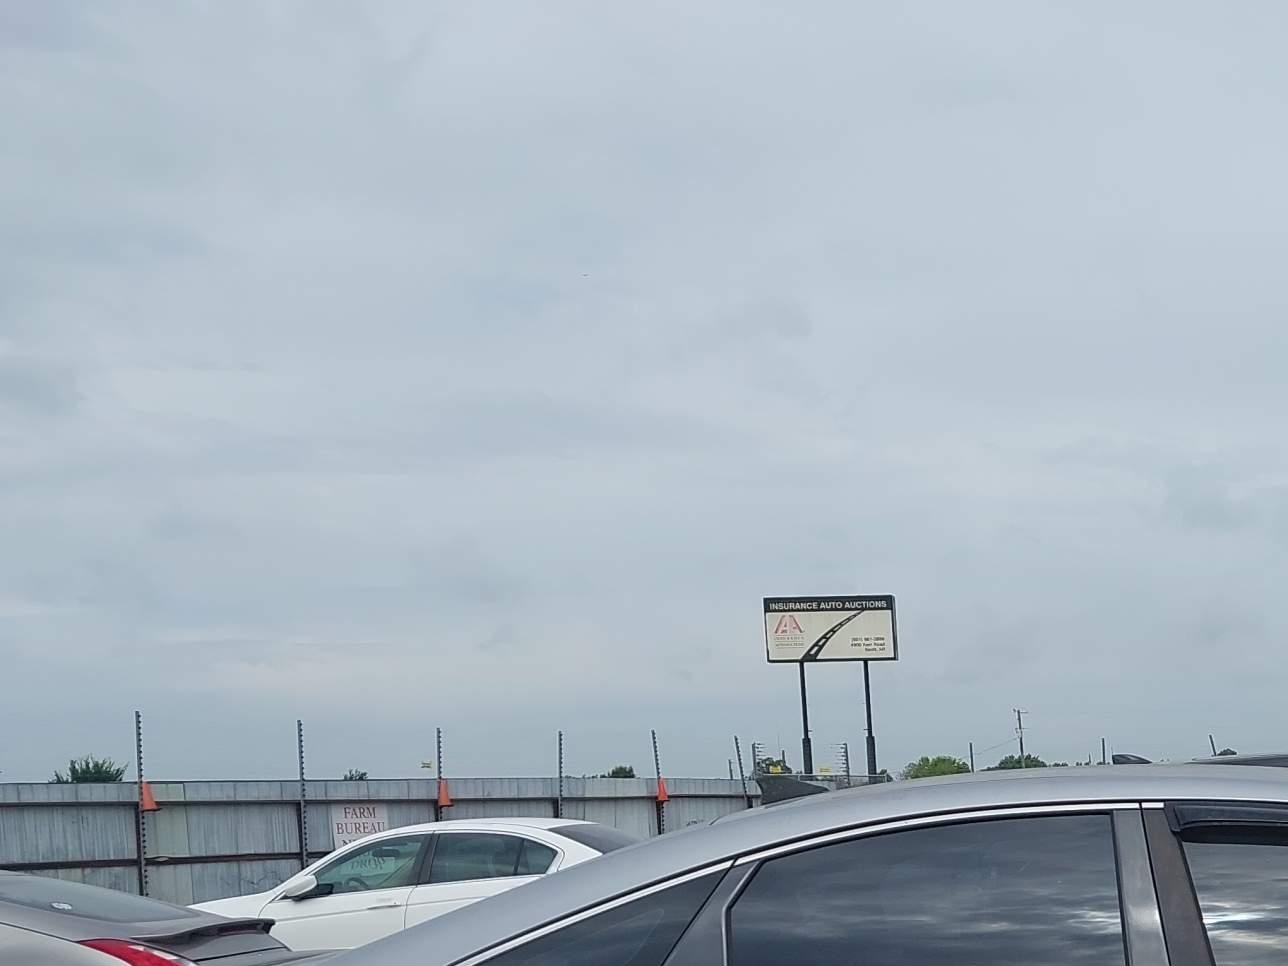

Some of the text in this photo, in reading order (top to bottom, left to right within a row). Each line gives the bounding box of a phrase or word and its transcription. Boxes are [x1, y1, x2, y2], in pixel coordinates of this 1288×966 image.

[769, 600, 887, 610] INSURANCE AUTO AUCTIONS
[344, 807, 377, 819] FARM
[336, 822, 385, 834] BUREAU
